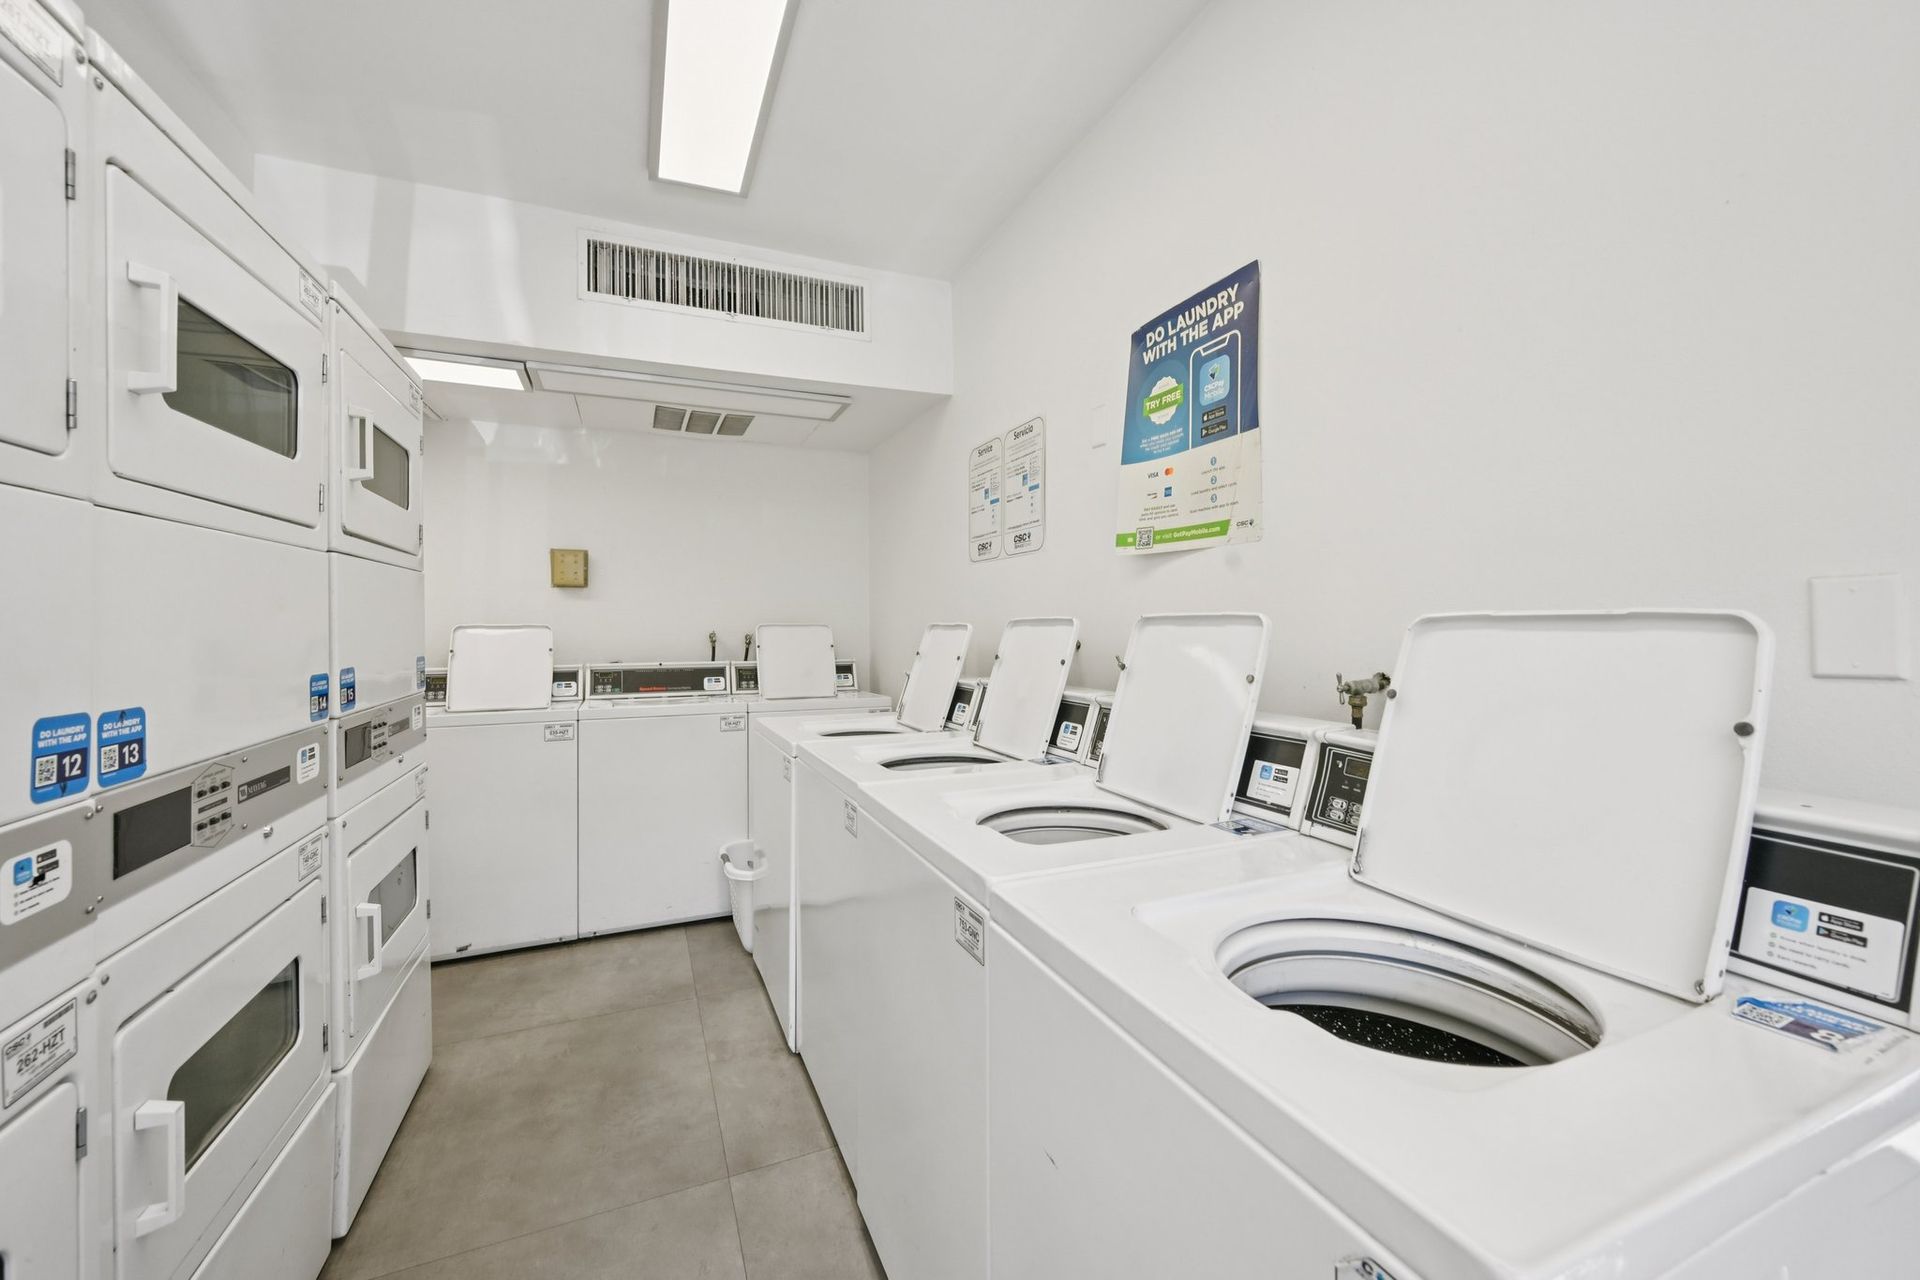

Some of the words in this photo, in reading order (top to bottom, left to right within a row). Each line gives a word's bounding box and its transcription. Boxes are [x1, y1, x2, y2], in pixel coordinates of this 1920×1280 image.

[1146, 326, 1165, 348] DO
[1167, 283, 1239, 336] LAUNDRY
[1143, 334, 1177, 365] WITH
[1180, 319, 1209, 347] THE
[1212, 301, 1244, 332] APP
[1145, 398, 1161, 411] TRY
[1162, 390, 1182, 405] FREE
[1013, 424, 1034, 440] Servicio
[977, 445, 993, 458] Service
[1147, 471, 1159, 479] VISA
[1013, 533, 1027, 543] CSC
[977, 542, 989, 552] CSC
[347, 688, 354, 700] 15
[318, 695, 327, 710] 14
[40, 730, 51, 739] DO
[52, 724, 85, 737] LAUNDRY
[102, 729, 118, 739] WITH
[119, 727, 130, 736] THE
[130, 725, 142, 733] APP
[103, 723, 113, 731] DO
[38, 738, 58, 748] WITH
[58, 735, 72, 744] THE
[73, 733, 87, 742] APP
[122, 743, 139, 765] 13
[62, 753, 82, 777] 12
[1810, 1029, 1845, 1043] 8
[16, 1027, 66, 1074] 262-HZT
